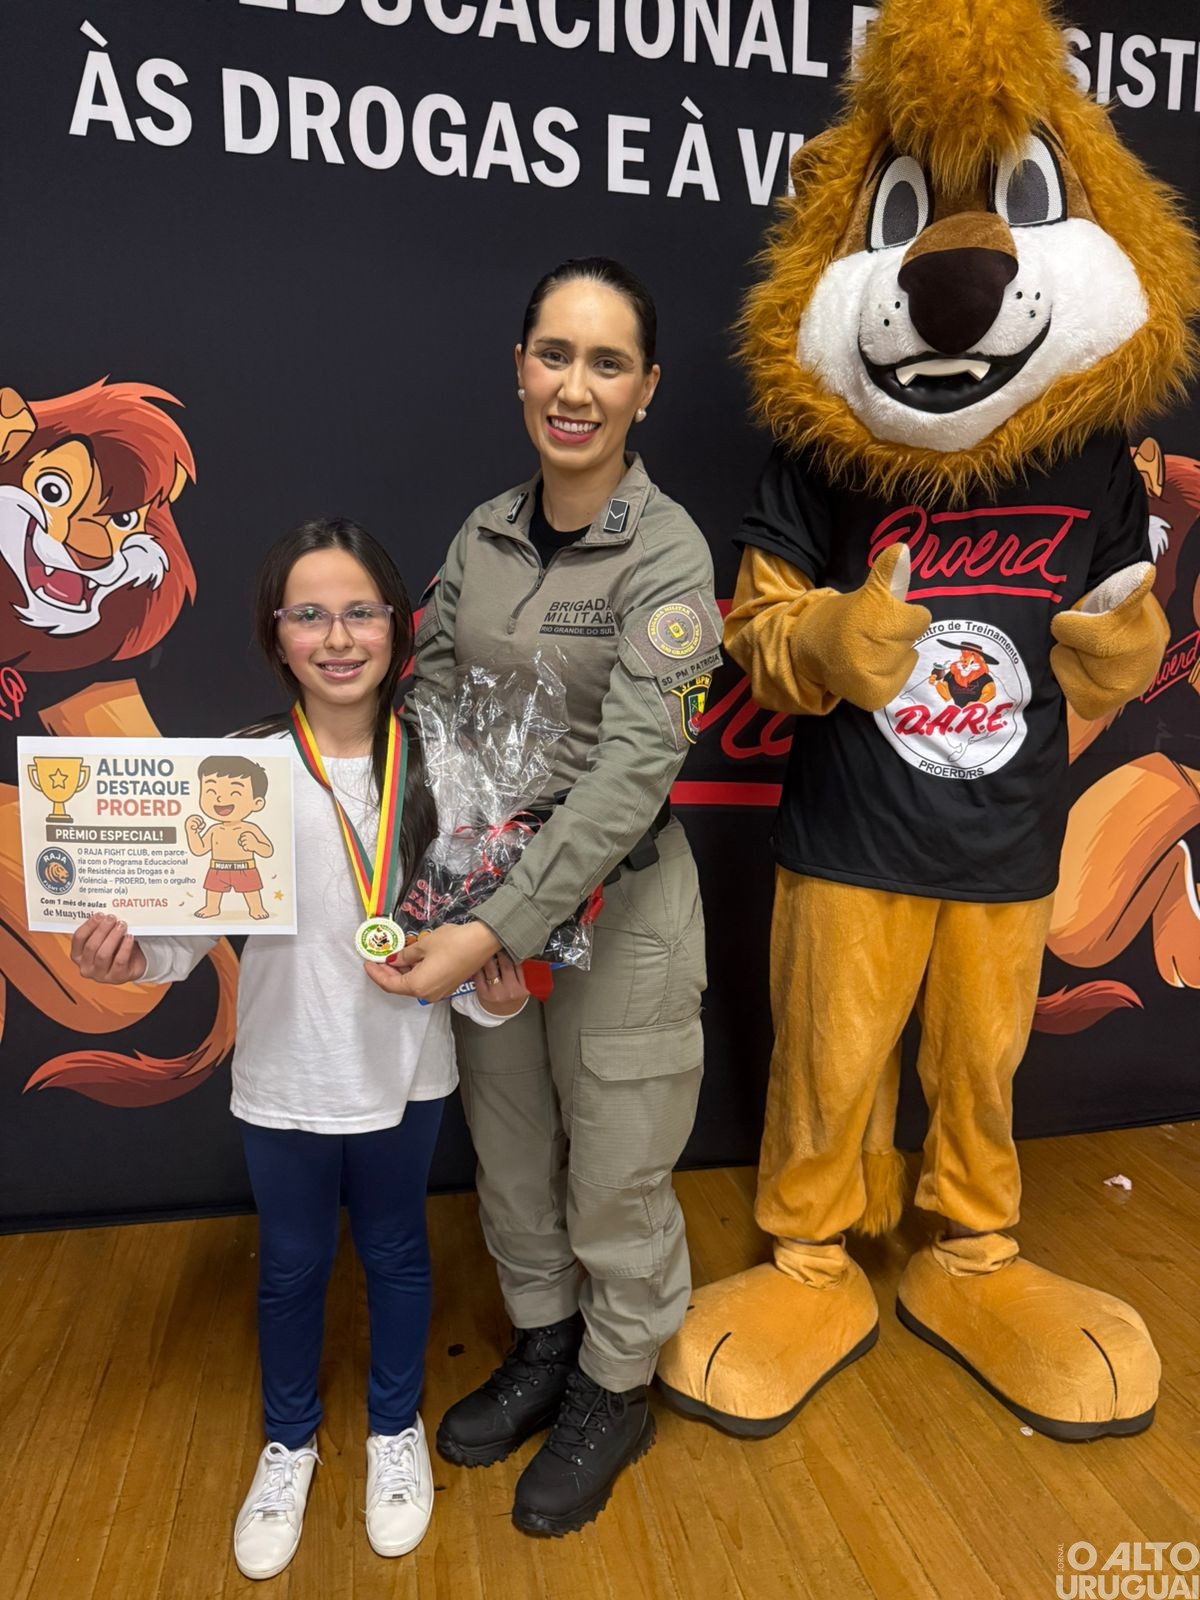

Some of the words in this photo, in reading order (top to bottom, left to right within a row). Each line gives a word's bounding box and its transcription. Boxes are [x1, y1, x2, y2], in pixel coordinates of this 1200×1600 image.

[69, 20, 192, 146] ÀS
[222, 67, 581, 188] DROGAS
[607, 114, 650, 195] E
[667, 96, 720, 201] À
[543, 612, 615, 624] MILITAR
[553, 626, 585, 635] GRANDE
[586, 628, 599, 636] DO
[600, 627, 614, 635] SUL
[948, 620, 961, 631] de
[965, 621, 1019, 665] Treinamento
[661, 677, 673, 686] SD
[675, 669, 689, 680] PM
[690, 653, 720, 674] PATRICIA
[96, 758, 175, 777] ALUNO
[96, 780, 190, 796] DESTAQUE
[96, 798, 182, 817] PROERD
[100, 830, 164, 841] ESPECIAL!
[43, 852, 67, 864] RAJA
[104, 848, 126, 856] FIGHT
[127, 849, 150, 857] CLUB,
[164, 850, 188, 858] parce-
[108, 858, 143, 867] Programa
[144, 858, 188, 866] Educacional
[78, 867, 86, 875] de
[87, 867, 126, 875] Resistência
[137, 868, 163, 876] Drogas
[78, 877, 108, 885] Violência
[114, 877, 147, 886] PROERD,
[170, 877, 196, 887] orgulho
[87, 887, 113, 895] premiar
[40, 897, 56, 905] Com
[64, 898, 76, 907] mês
[78, 899, 86, 907] de
[87, 900, 107, 908] aulas
[112, 898, 168, 908] GRATUITAS
[43, 908, 54, 917] de
